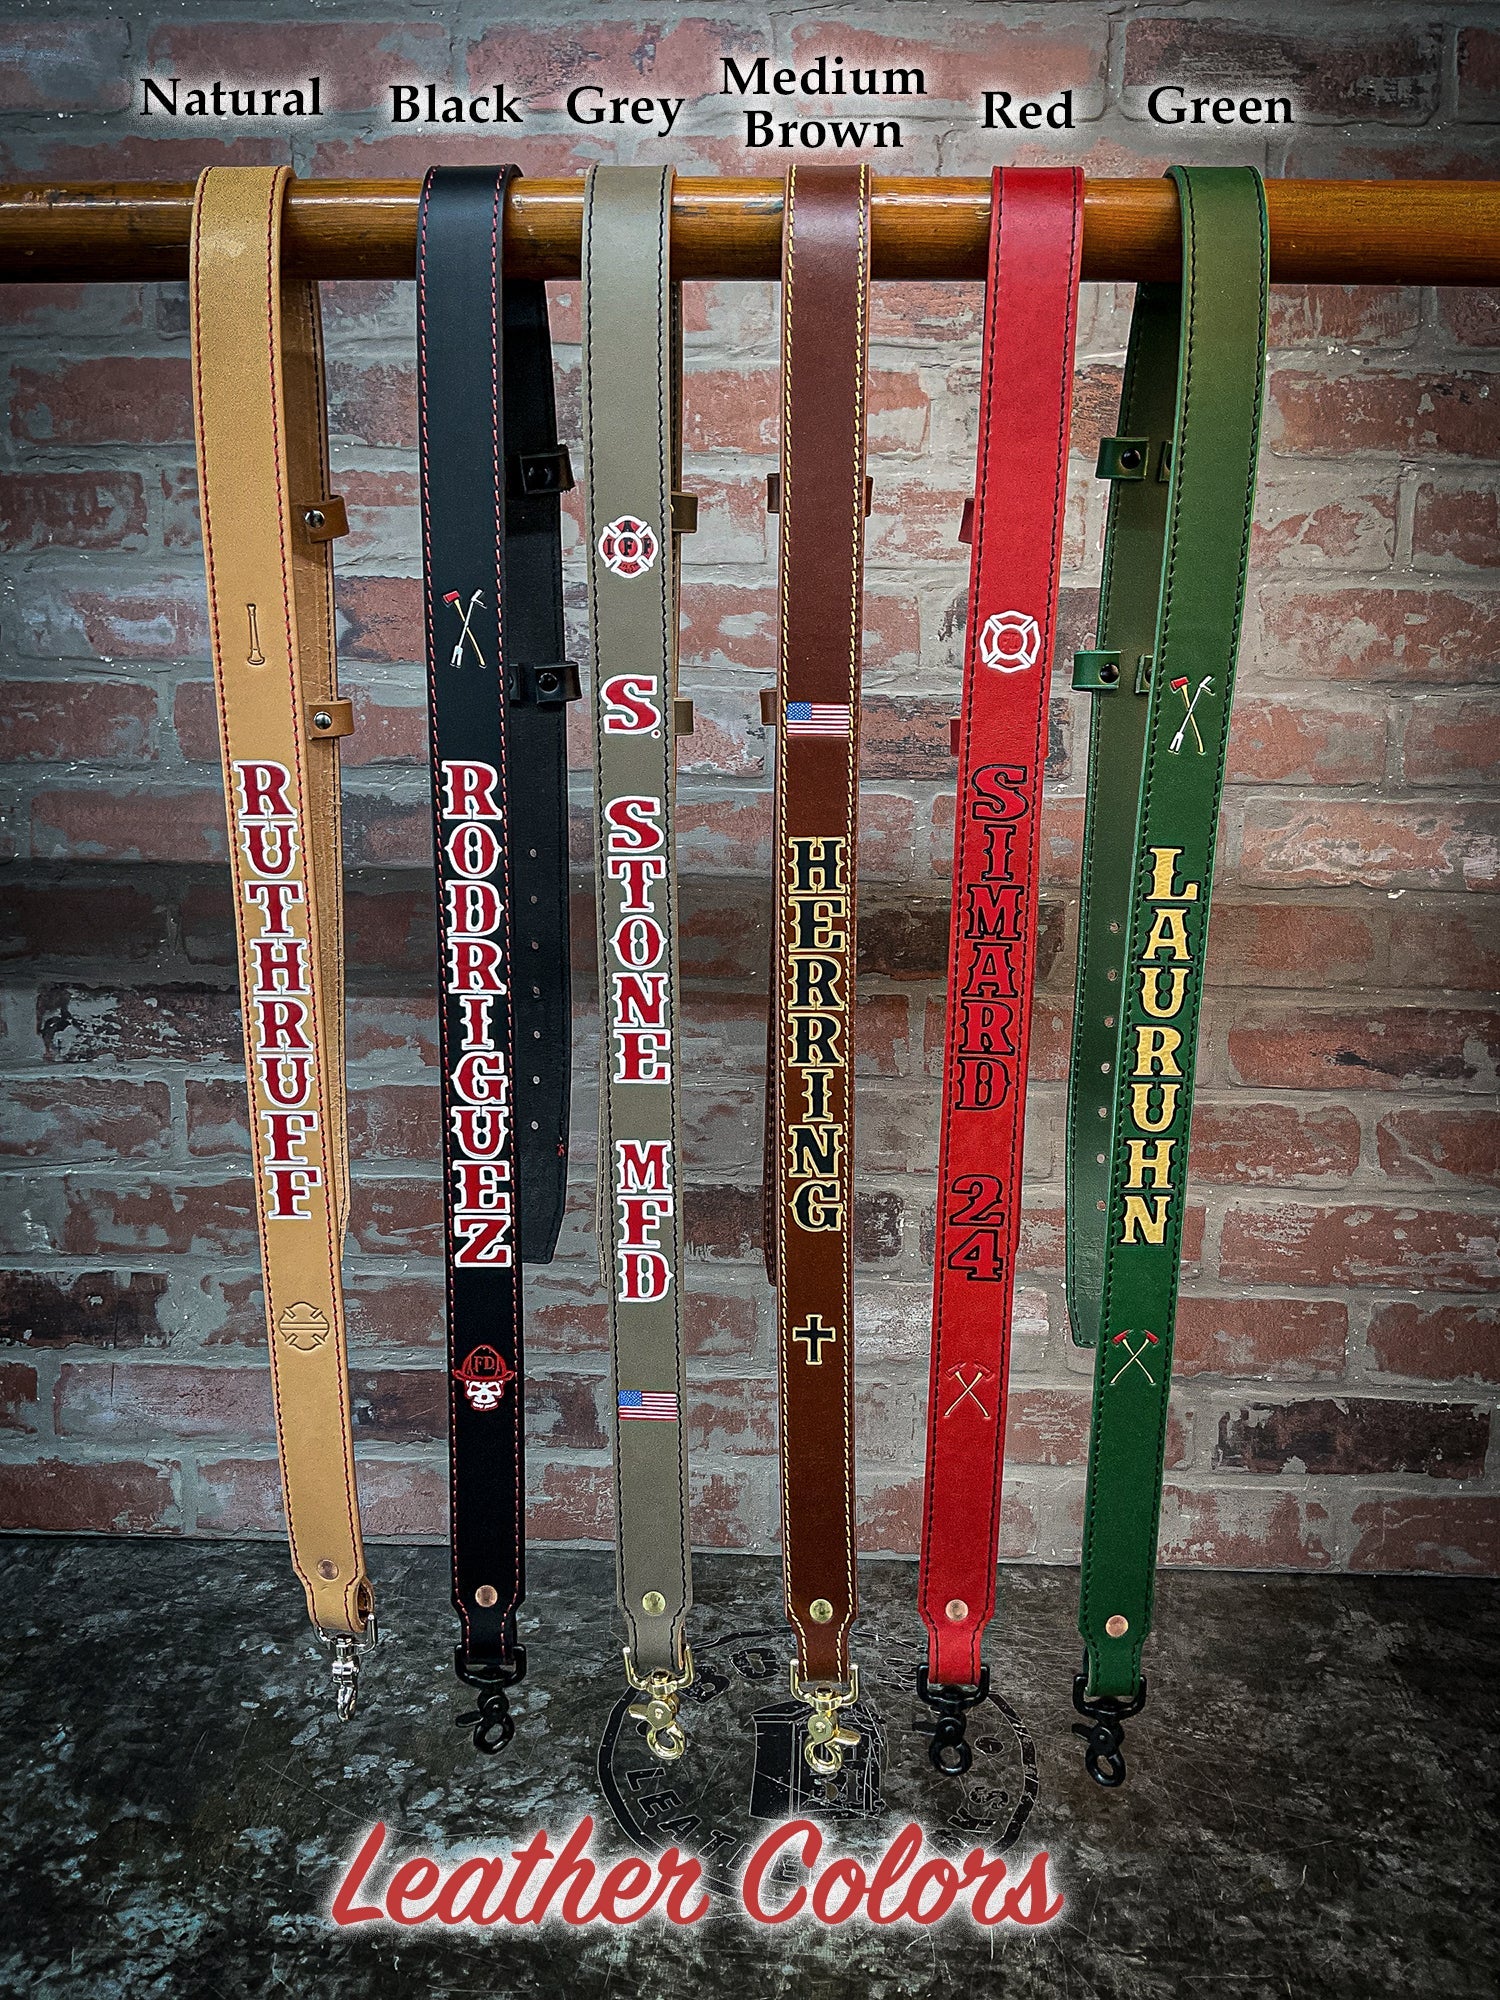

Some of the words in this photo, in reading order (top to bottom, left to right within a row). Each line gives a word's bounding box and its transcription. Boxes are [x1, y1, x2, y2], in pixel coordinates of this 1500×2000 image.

[601, 674, 661, 739] S.
[232, 760, 322, 1220] RUTHRUFF
[441, 760, 511, 1268] RODRIGUEZ
[605, 796, 671, 1084] STONE
[788, 836, 848, 1232] HERRING
[954, 765, 1030, 1112] SIMARD
[1117, 846, 1201, 1246] LAURUHN
[615, 1140, 674, 1302] MFD
[947, 1174, 1006, 1283] 24
